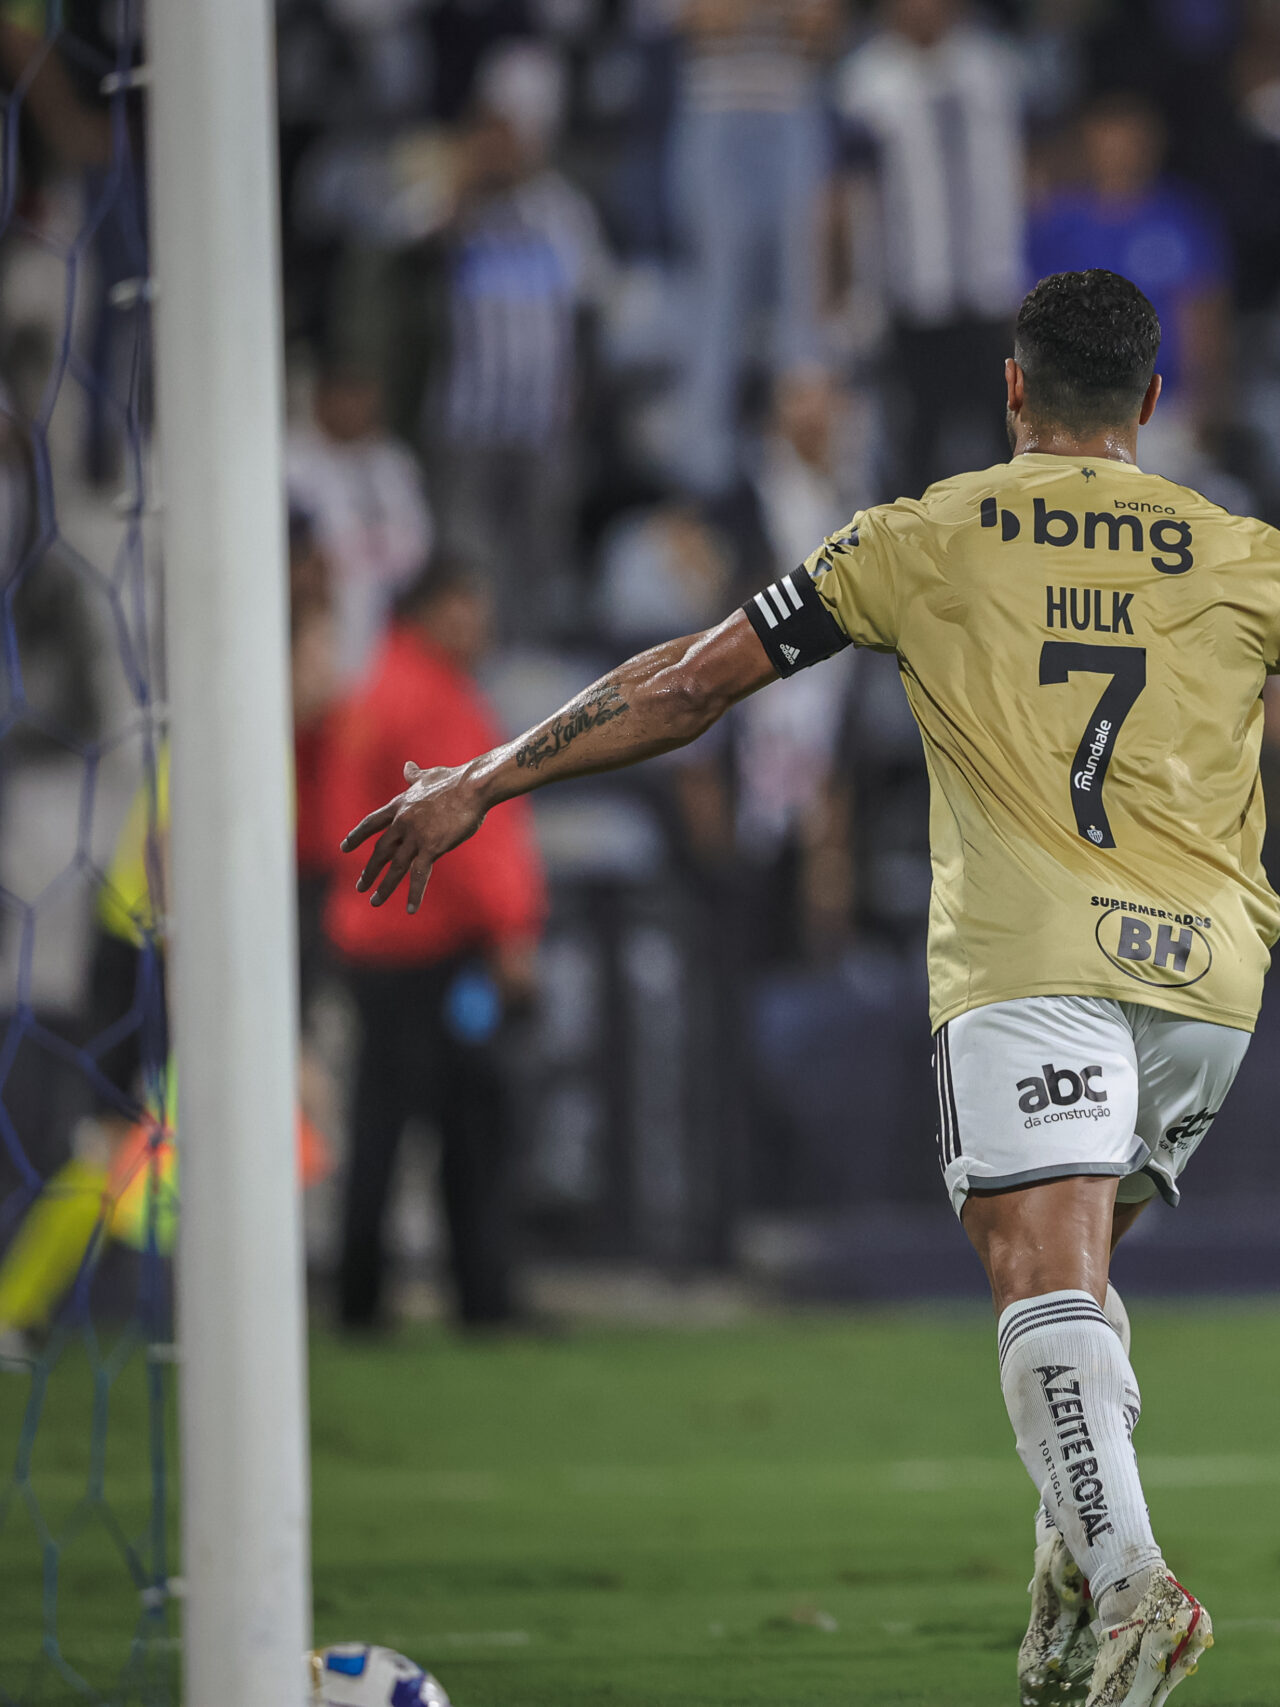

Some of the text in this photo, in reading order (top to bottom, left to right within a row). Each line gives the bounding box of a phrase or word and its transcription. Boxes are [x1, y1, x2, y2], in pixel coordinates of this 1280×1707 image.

[1113, 499, 1176, 515] banco
[1032, 497, 1194, 575] bmg
[1046, 585, 1135, 635] HULK
[780, 643, 796, 665] adidas
[1038, 640, 1147, 849] 7
[1074, 719, 1112, 792] mundiale
[1090, 895, 1213, 930] SUPERMERCADOS
[1117, 915, 1194, 973] BH
[1015, 1063, 1108, 1114] abc
[1023, 1105, 1111, 1130] da construção
[1032, 1364, 1113, 1547] AZEITE ROYAL
[1038, 1439, 1066, 1507] PORTUGAL
